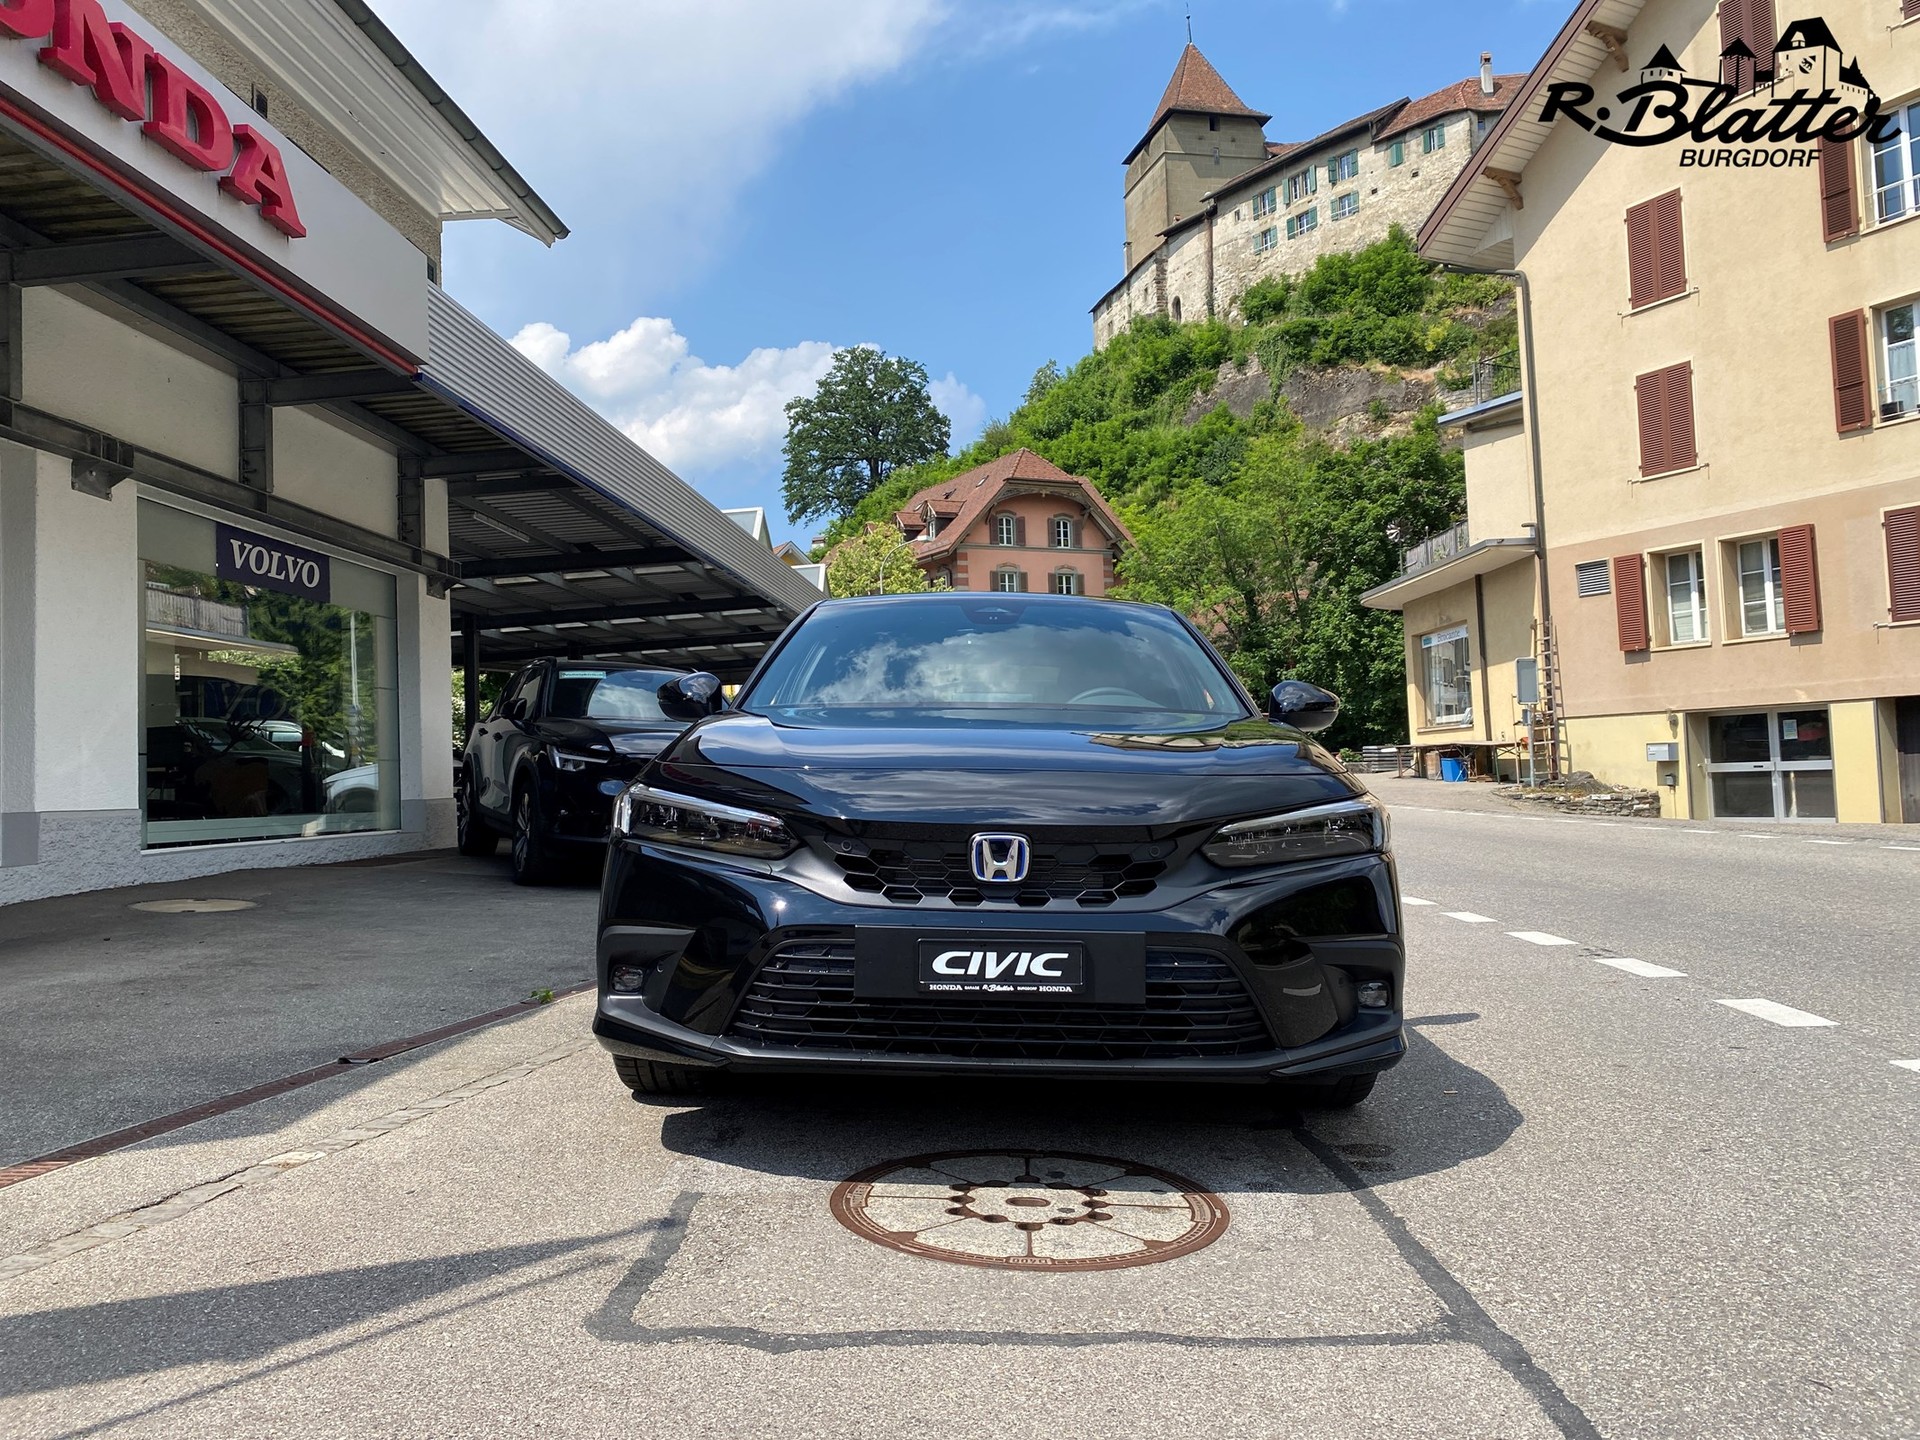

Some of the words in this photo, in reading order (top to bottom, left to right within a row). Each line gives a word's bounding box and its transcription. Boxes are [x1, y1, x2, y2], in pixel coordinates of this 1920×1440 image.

[230, 539, 320, 588] VOLVO
[932, 951, 1069, 979] CIVIC
[1039, 985, 1073, 993] HONDA
